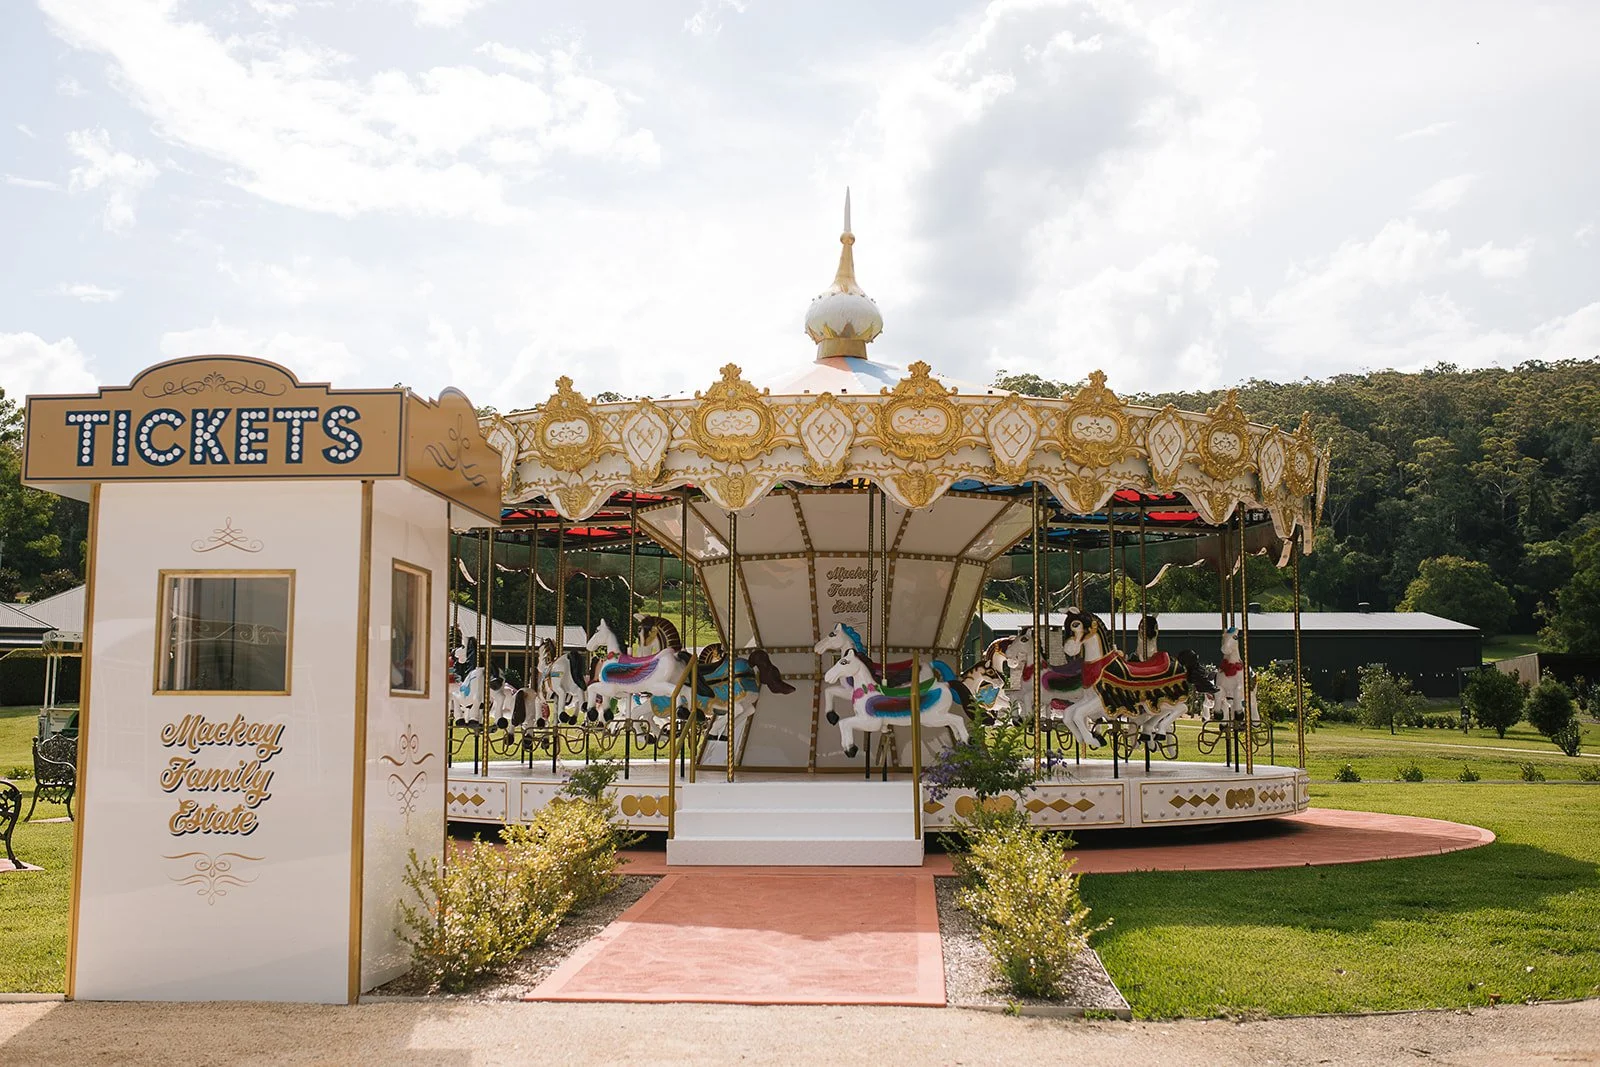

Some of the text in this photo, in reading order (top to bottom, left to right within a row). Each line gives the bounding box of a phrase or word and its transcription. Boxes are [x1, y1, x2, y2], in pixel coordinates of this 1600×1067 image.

[65, 405, 362, 467] TICKETS
[832, 599, 870, 614] Estate
[160, 713, 285, 763] Mackay
[160, 756, 274, 808] Family
[168, 798, 259, 836] Estate
